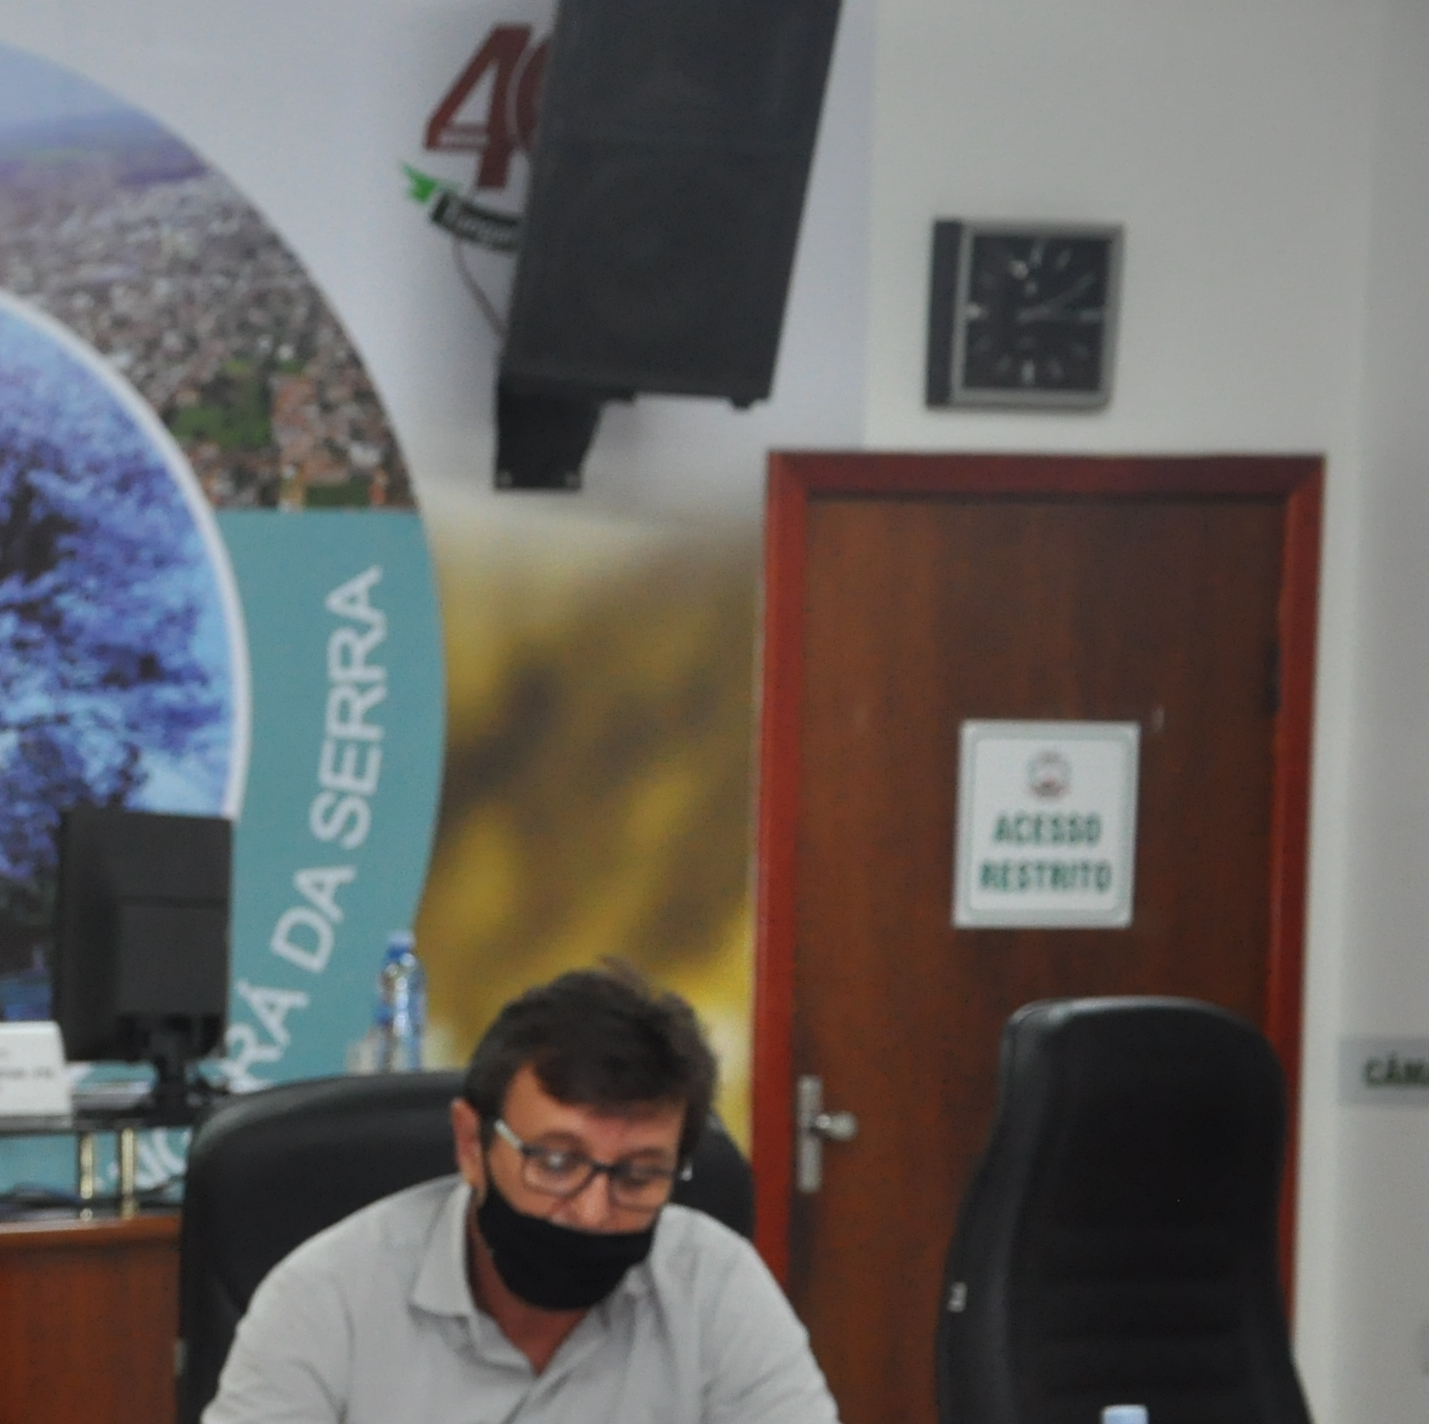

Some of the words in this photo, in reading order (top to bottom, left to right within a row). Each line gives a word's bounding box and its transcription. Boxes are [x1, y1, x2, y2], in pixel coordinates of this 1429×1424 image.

[309, 565, 389, 850] SERRA
[994, 811, 1102, 848] ACESSO
[979, 858, 1114, 896] RESTRITO
[271, 865, 357, 973] DA
